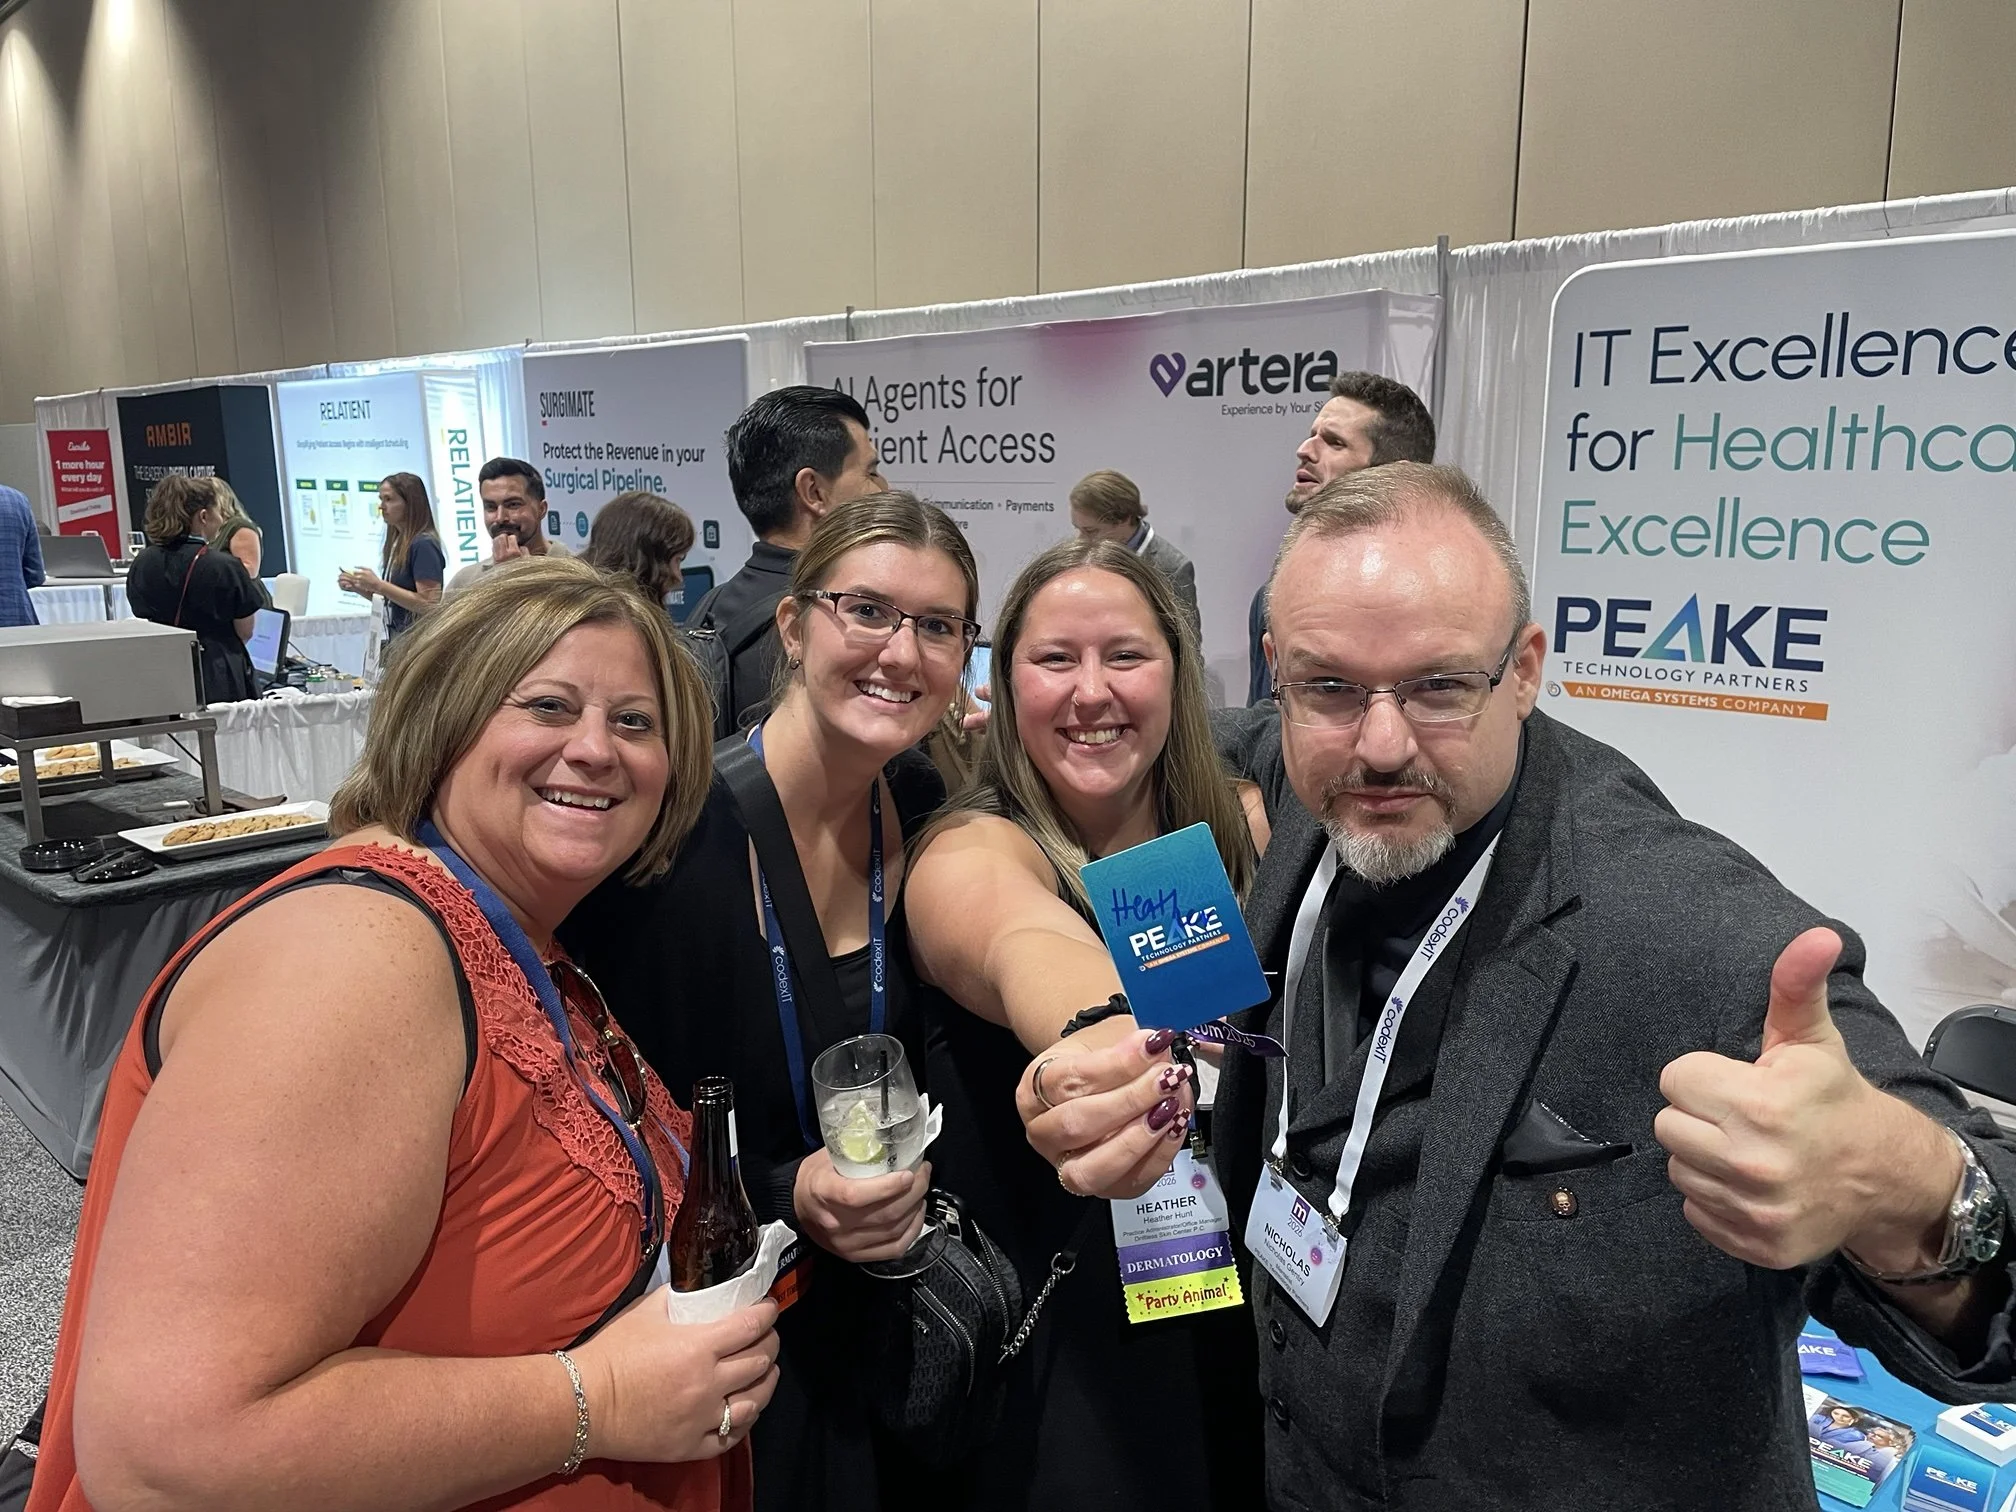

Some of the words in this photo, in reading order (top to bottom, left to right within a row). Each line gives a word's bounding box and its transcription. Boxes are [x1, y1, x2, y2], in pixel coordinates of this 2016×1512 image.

[1573, 328, 1632, 388] IT
[1650, 311, 2016, 385] Excellenc
[1186, 348, 1338, 398] artera
[320, 400, 371, 421] RELATIENT
[539, 390, 596, 418] SURGIMATE
[864, 374, 967, 424] Agents
[976, 366, 1023, 407] for
[1221, 402, 1273, 418] Experience
[1275, 402, 1288, 416] by
[1290, 401, 1311, 414] Your
[145, 421, 192, 448] AMBIR
[869, 426, 929, 465] ient
[937, 424, 1056, 465] Access
[1567, 412, 1655, 472] for
[1672, 404, 2016, 473] Healthca
[55, 460, 61, 470] 1
[61, 461, 84, 470] more
[84, 459, 105, 470] hour
[543, 442, 583, 460] Protect
[584, 442, 604, 460] the
[606, 443, 659, 461] Revenue
[662, 444, 674, 462] in
[676, 447, 706, 467] your
[61, 474, 86, 484] every
[86, 472, 103, 484] day
[544, 466, 599, 494] Surgical
[602, 467, 668, 494] Pipeline.
[447, 428, 480, 563] RELATIENT
[922, 498, 994, 511] mmunication
[1006, 499, 1055, 514] Payments
[1559, 496, 1931, 566] Excellence
[1553, 592, 1829, 673] PEAKE
[1563, 661, 1696, 684] TECHNOLOGY
[1703, 671, 1809, 693] PARTNERS
[1575, 685, 1597, 697] AN
[1600, 687, 1651, 702] OMEGA
[1654, 691, 1718, 708] SYSTEMS
[1722, 697, 1806, 717] COMPANY
[761, 872, 773, 908] exIT
[1128, 905, 1224, 957] PEAKE
[1141, 940, 1187, 962] TECHNOLOGY
[1187, 929, 1222, 946] PARTNERS
[1420, 907, 1459, 962] codexIT
[873, 937, 883, 983] codexIT
[774, 955, 793, 1004] codexIT
[1373, 1008, 1397, 1065] codexIT
[1156, 1176, 1177, 1188] 2026
[1136, 1195, 1198, 1215] HEATHER
[1143, 1214, 1173, 1225] Heather
[1175, 1210, 1194, 1219] Hunt
[1287, 1217, 1304, 1238] 2026
[1127, 1245, 1224, 1273] DERMATOLOGY
[1264, 1222, 1312, 1277] NICHOLAS
[1145, 1294, 1179, 1311] Party
[1182, 1283, 1228, 1304] Animal
[1799, 1343, 1837, 1357] AKE
